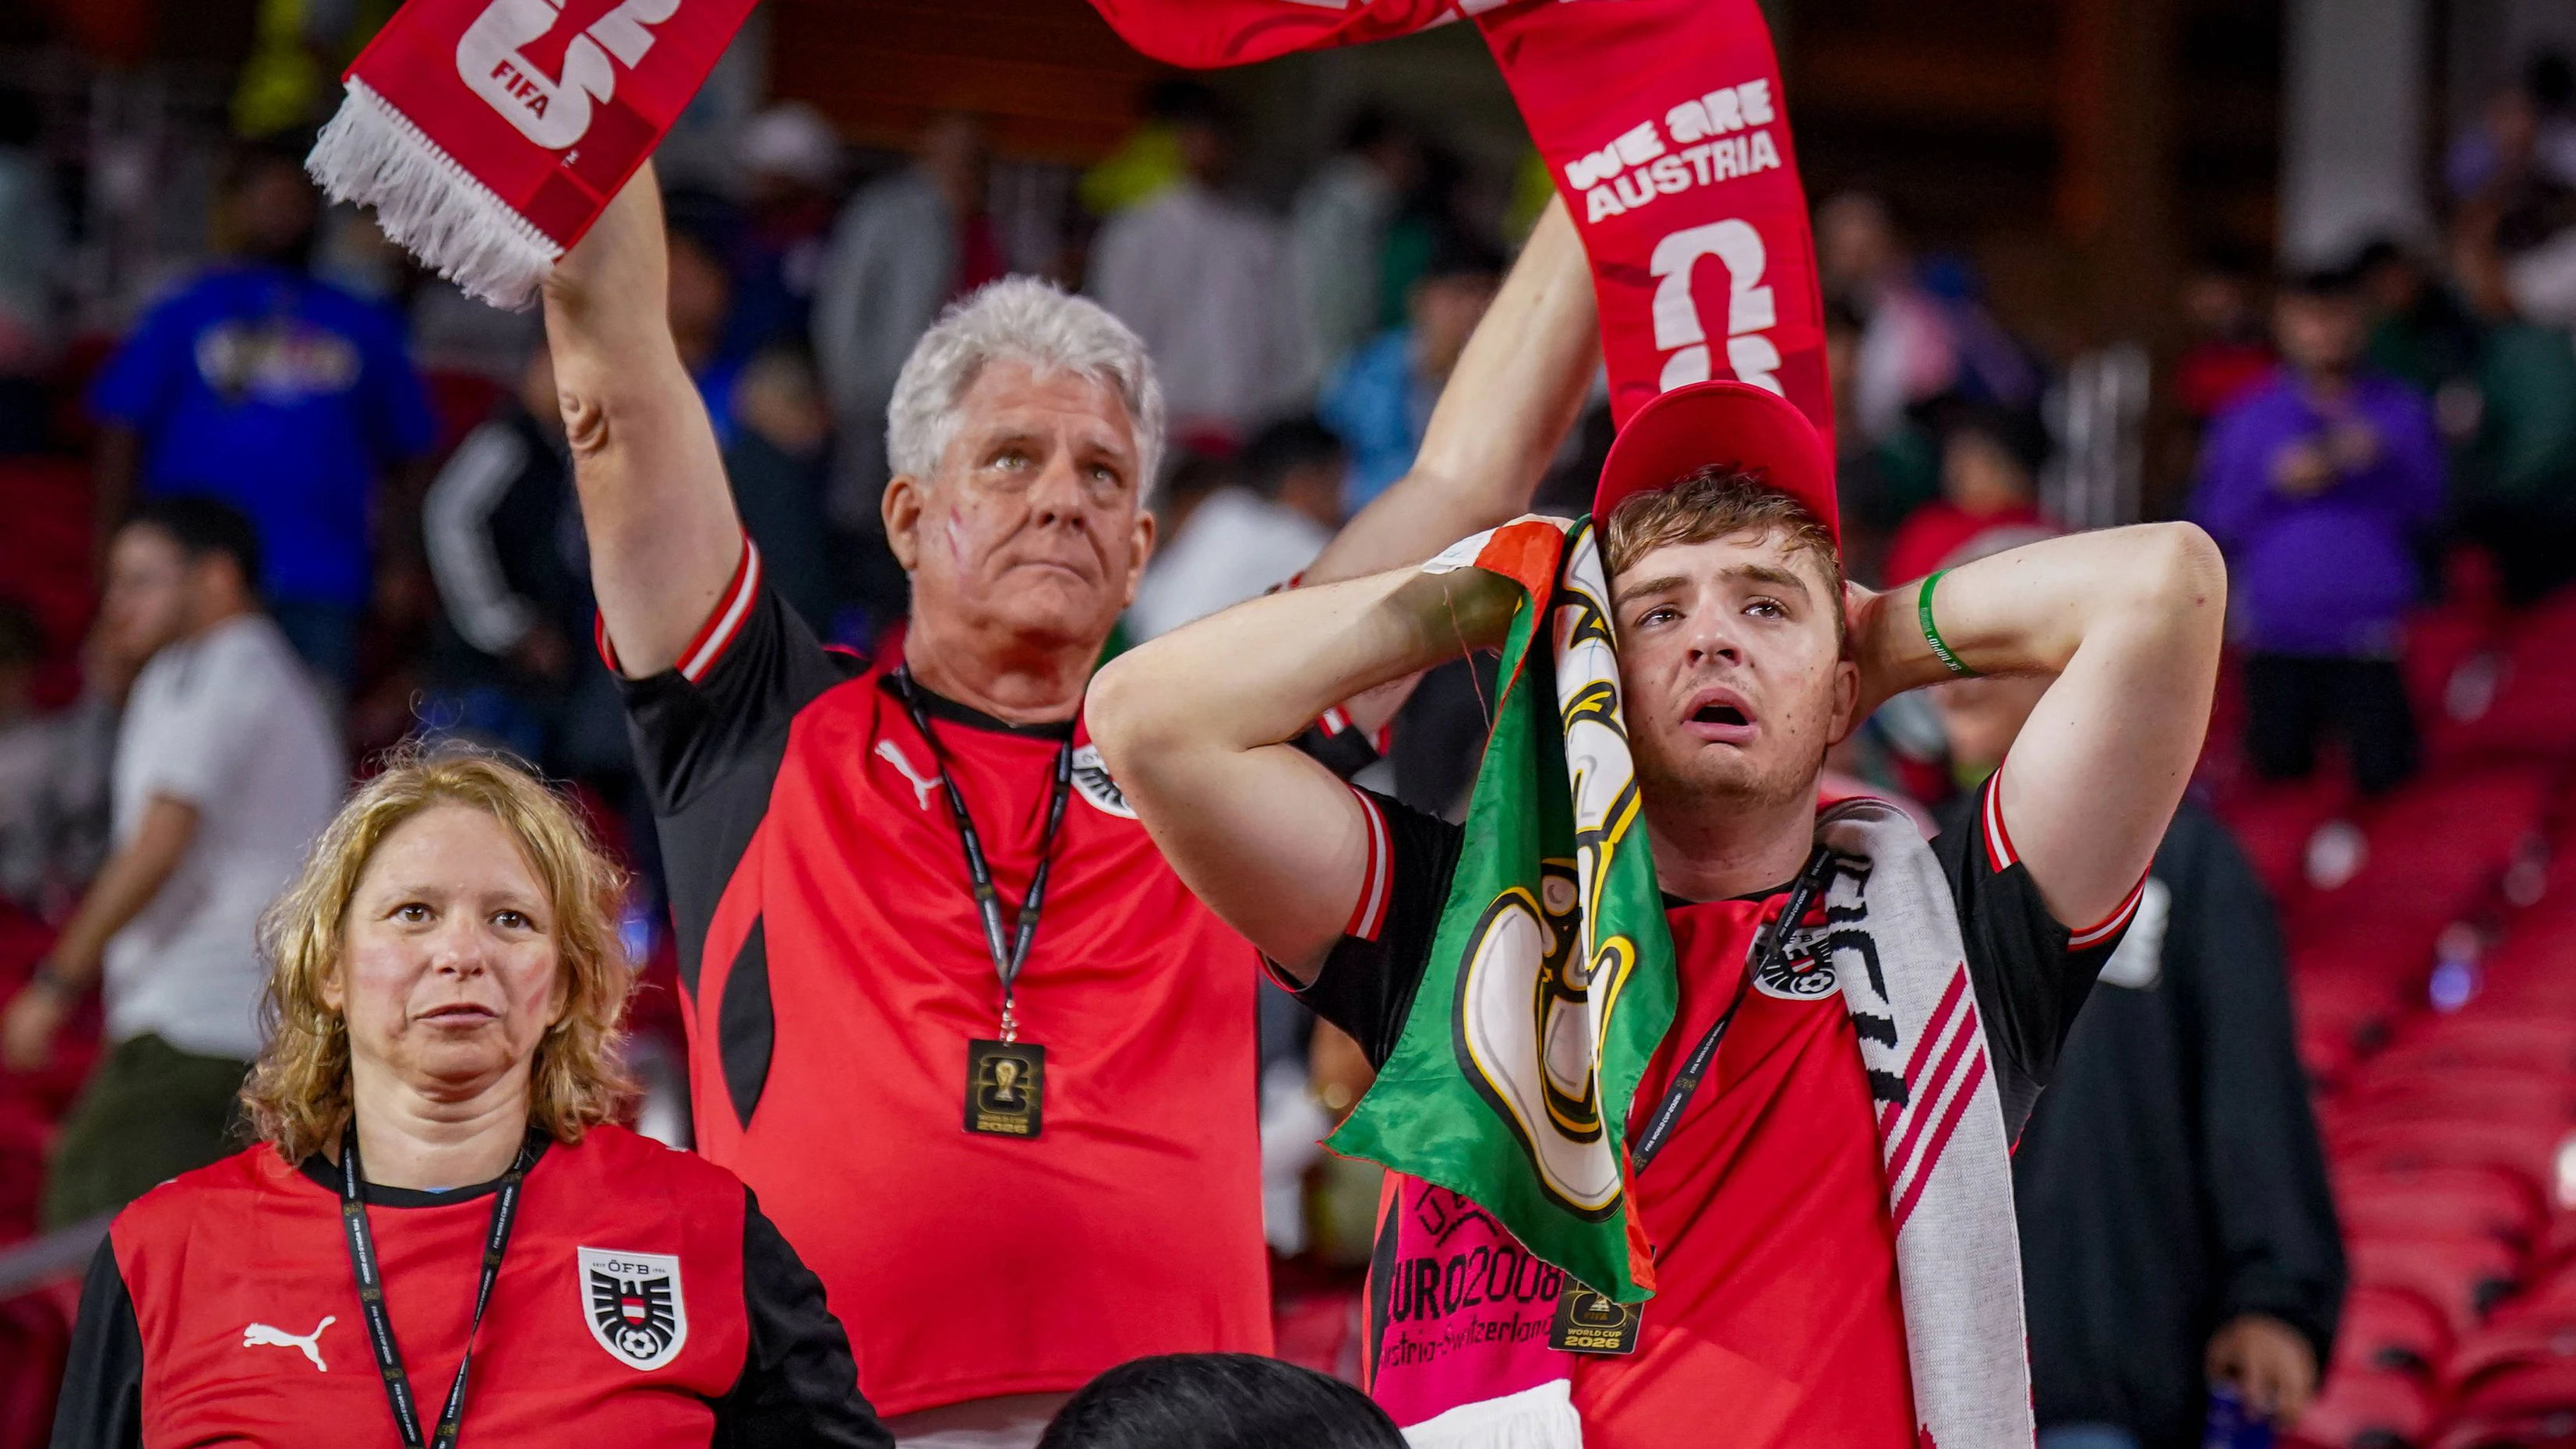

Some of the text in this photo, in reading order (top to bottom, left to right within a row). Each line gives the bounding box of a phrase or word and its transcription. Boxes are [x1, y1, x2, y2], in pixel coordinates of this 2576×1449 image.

[490, 59, 549, 121] FIFA
[1564, 119, 1666, 191] WE
[1585, 129, 1782, 224] AUSTRIA
[1928, 637, 1953, 661] RAPID
[1645, 1141, 1654, 1151] FIFA
[1652, 1123, 1665, 1140] WORLD
[355, 1232, 364, 1252] WORLD
[608, 1259, 649, 1274] ÖFB
[1392, 1245, 1561, 1322] URO2008
[1564, 1336, 1620, 1349] 2026
[1568, 1328, 1602, 1337] WORLD
[398, 1396, 407, 1413] WORLD
